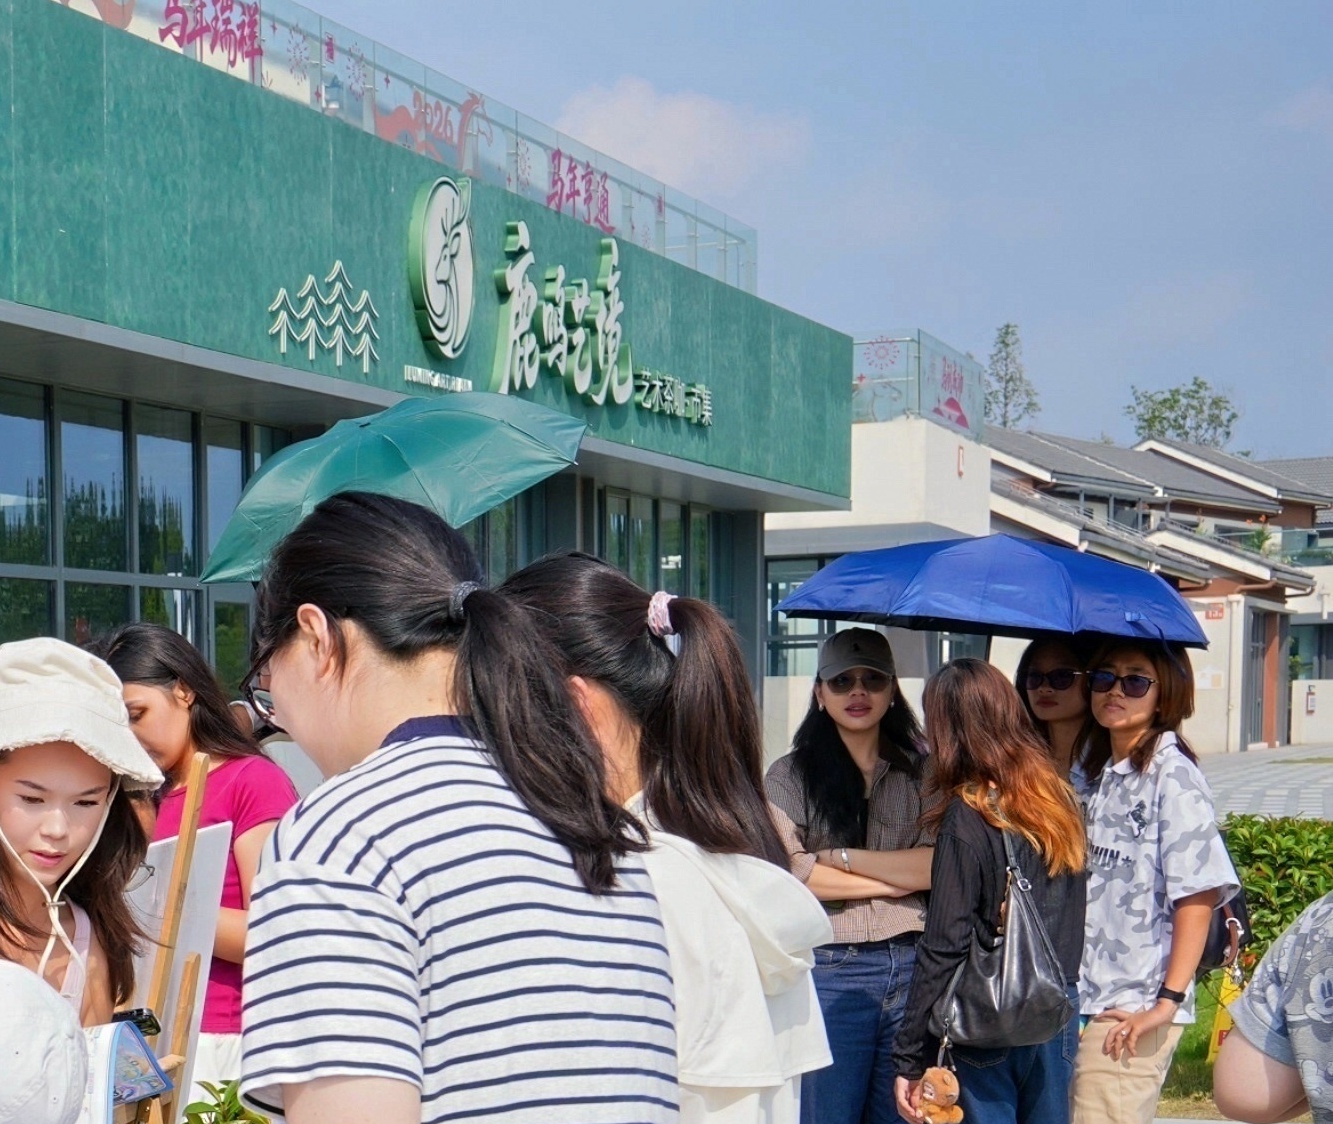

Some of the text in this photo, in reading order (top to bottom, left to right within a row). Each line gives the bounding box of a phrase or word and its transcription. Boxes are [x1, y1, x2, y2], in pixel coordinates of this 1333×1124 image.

[413, 90, 454, 146] 2026
[546, 147, 616, 235] 马年亨通
